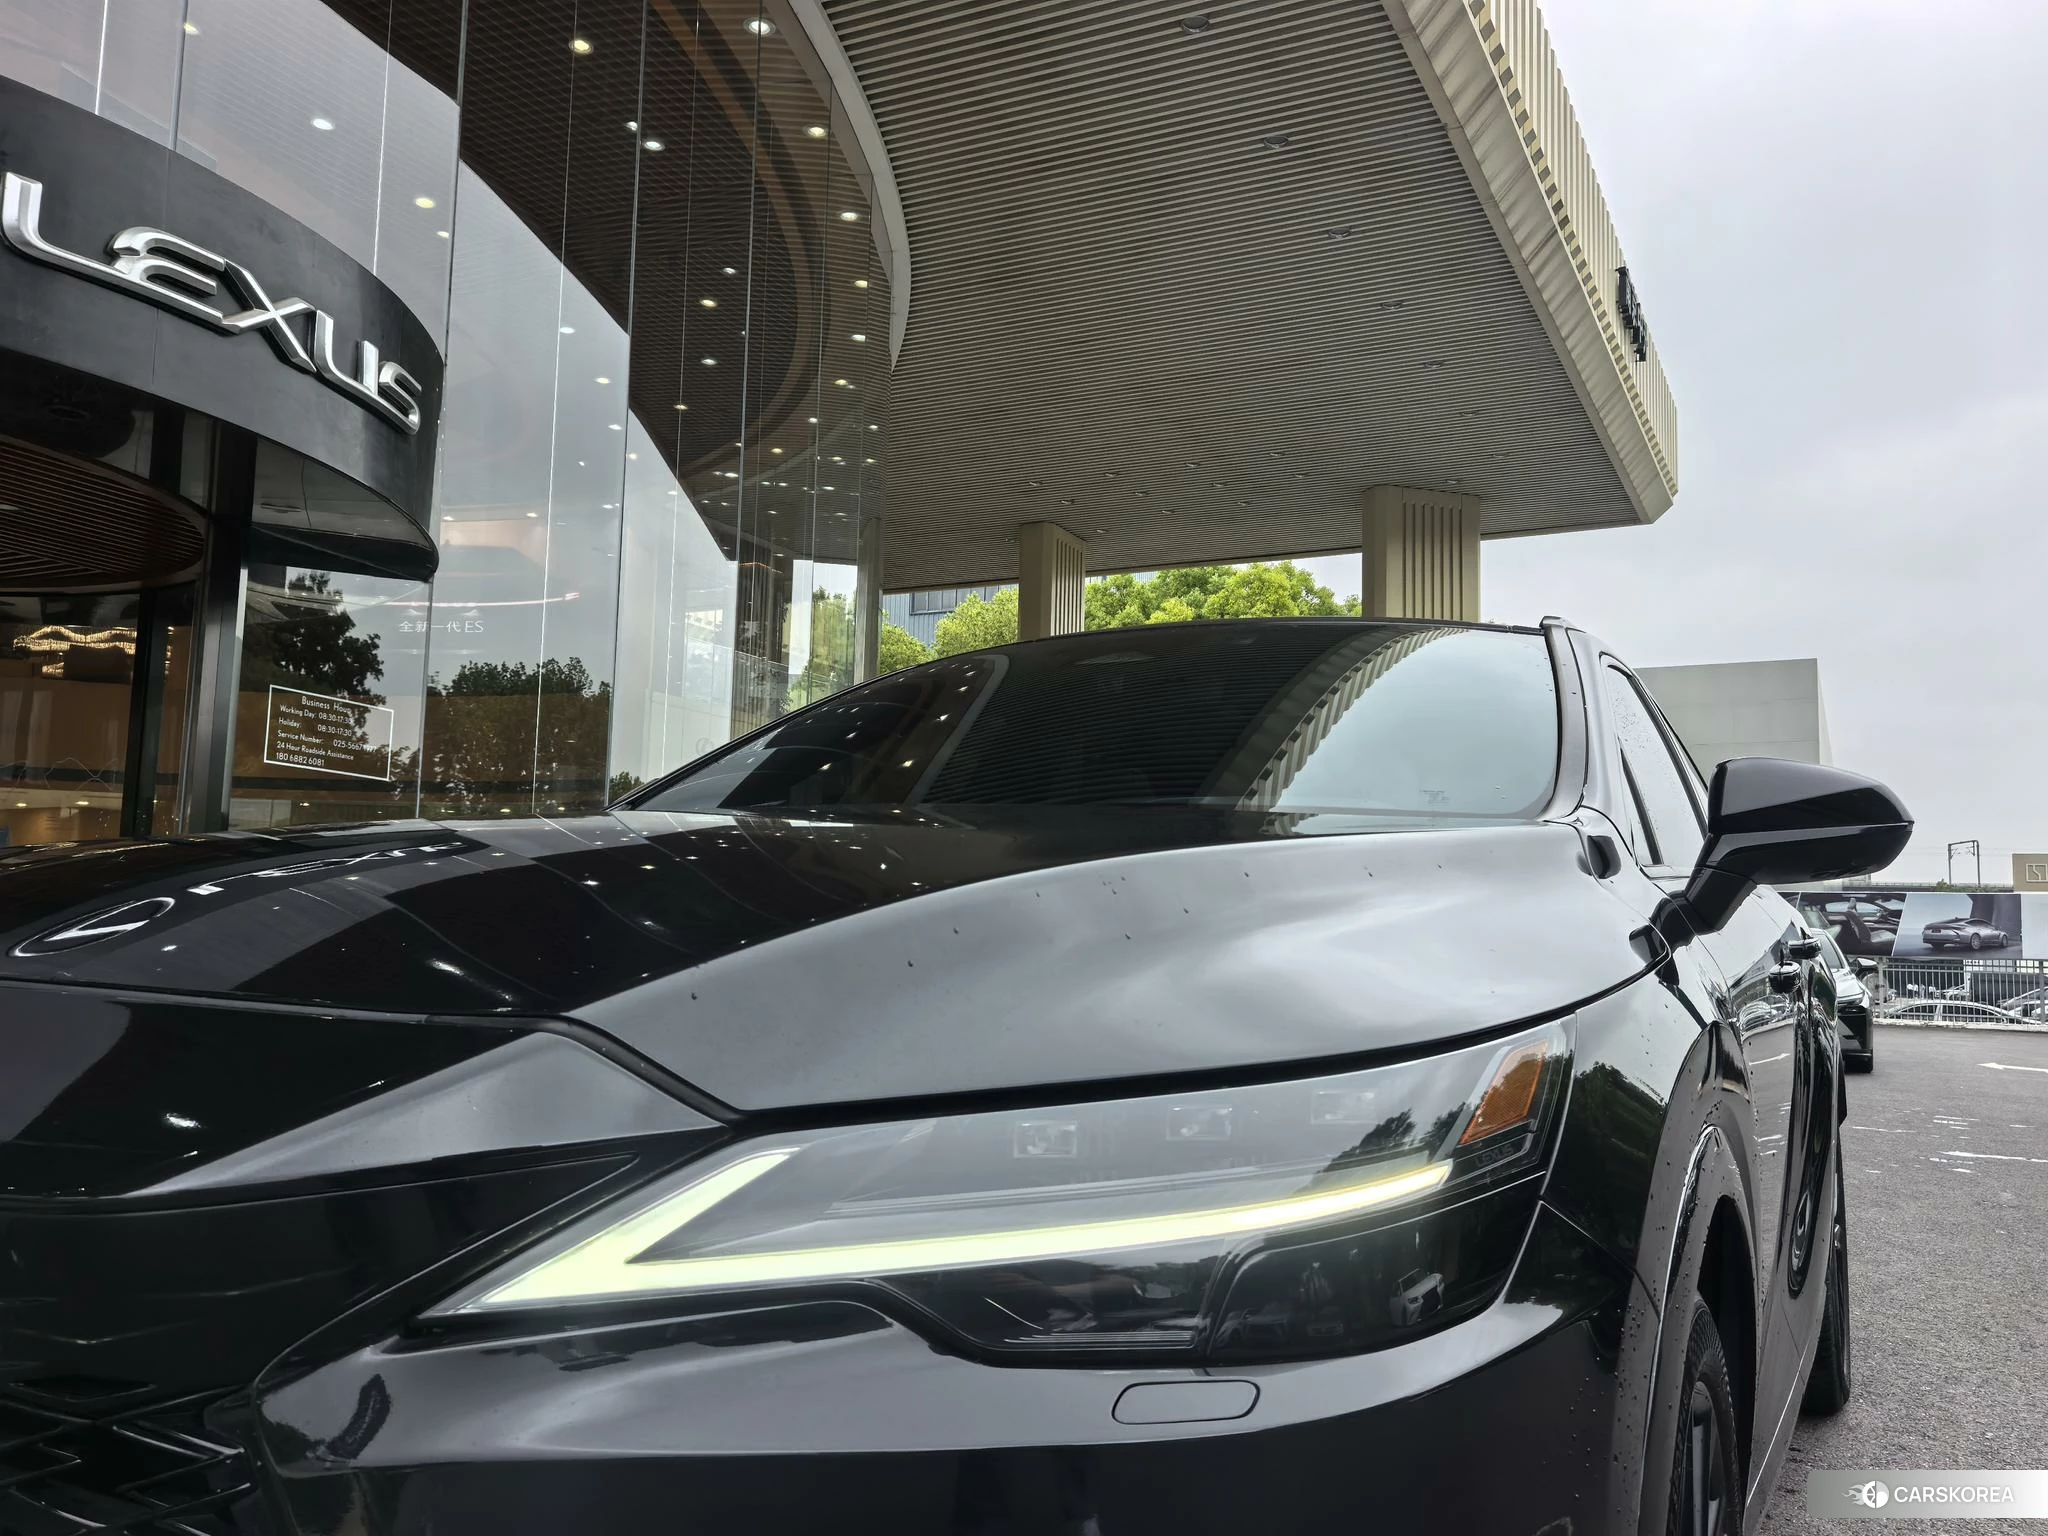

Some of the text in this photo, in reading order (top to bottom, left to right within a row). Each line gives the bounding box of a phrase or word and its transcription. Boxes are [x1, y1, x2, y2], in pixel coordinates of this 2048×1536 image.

[2, 172, 421, 434] LEXUS
[465, 620, 484, 633] ES
[301, 695, 330, 710] Business
[280, 704, 303, 717] Working
[304, 709, 317, 720] Day:
[278, 717, 353, 737] Holiday: 08:30-17:30
[277, 729, 299, 741] Service
[300, 733, 324, 745] Number:
[276, 741, 354, 760] 24 Hour Roadside Assistance
[276, 752, 325, 766] 180 6882 6081
